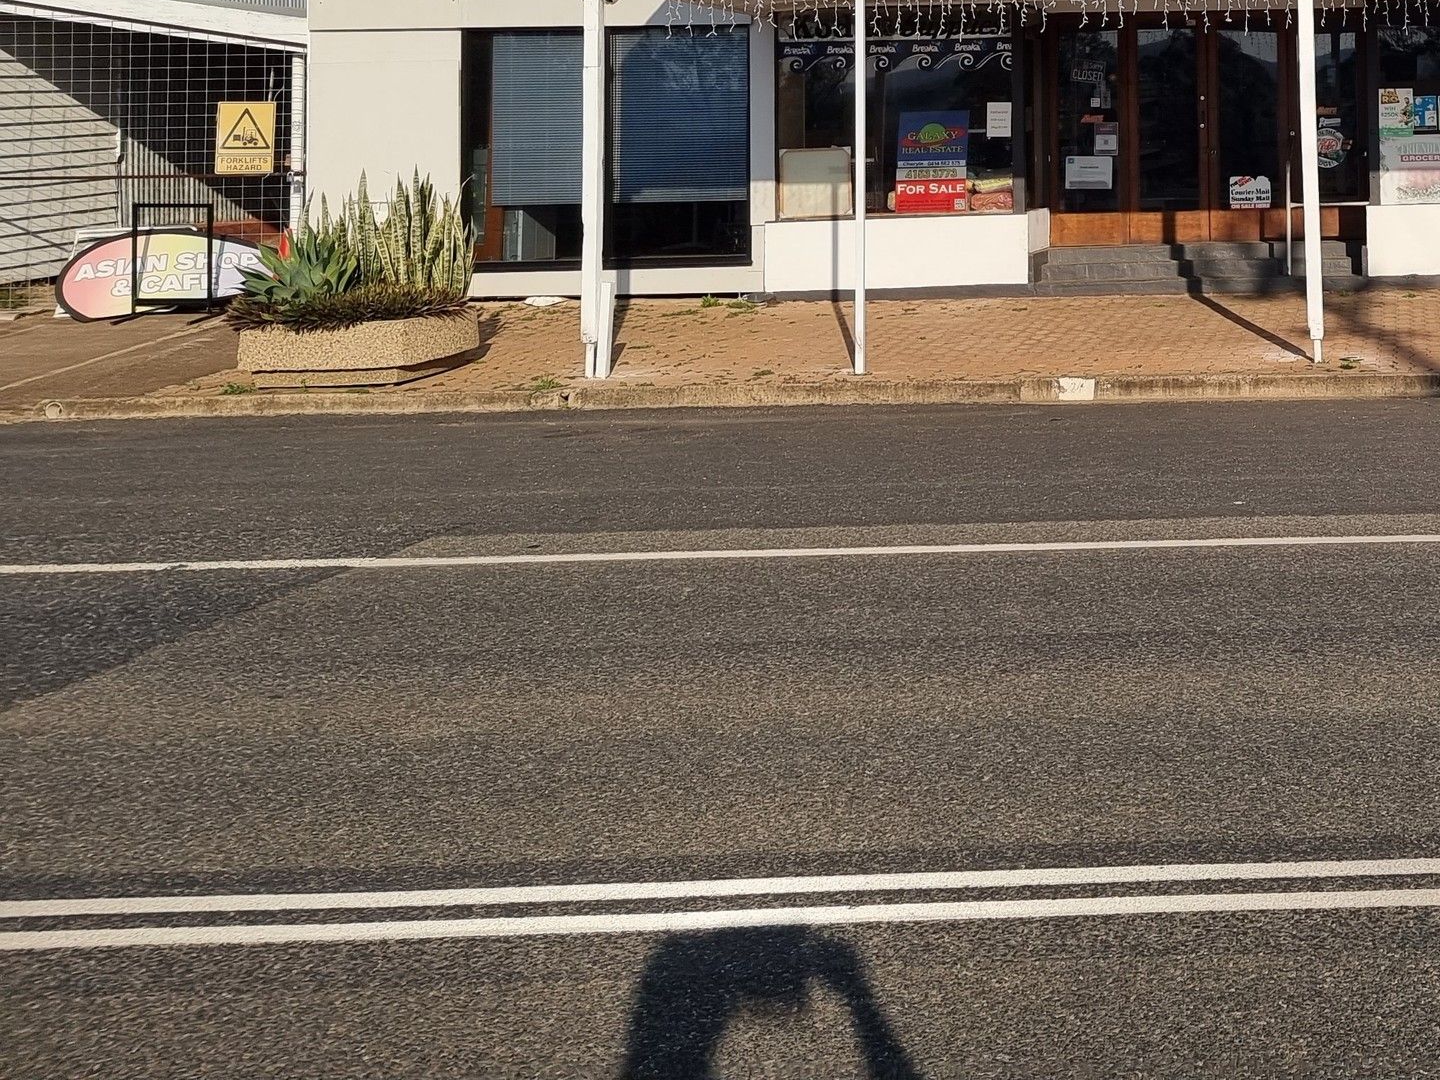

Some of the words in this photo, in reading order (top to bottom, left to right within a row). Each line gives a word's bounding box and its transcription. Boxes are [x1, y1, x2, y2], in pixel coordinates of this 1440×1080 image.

[869, 44, 896, 54] Breaka
[911, 44, 940, 53] Breaka
[954, 42, 981, 52] Breaka
[1072, 69, 1104, 81] CLOSED
[907, 129, 959, 141] GALAXY
[929, 145, 964, 153] ESTATE
[897, 184, 926, 195] FOR
[929, 183, 965, 194] SALE
[74, 253, 169, 283] ASIAN
[174, 251, 260, 271] SHOP
[110, 278, 131, 297] &
